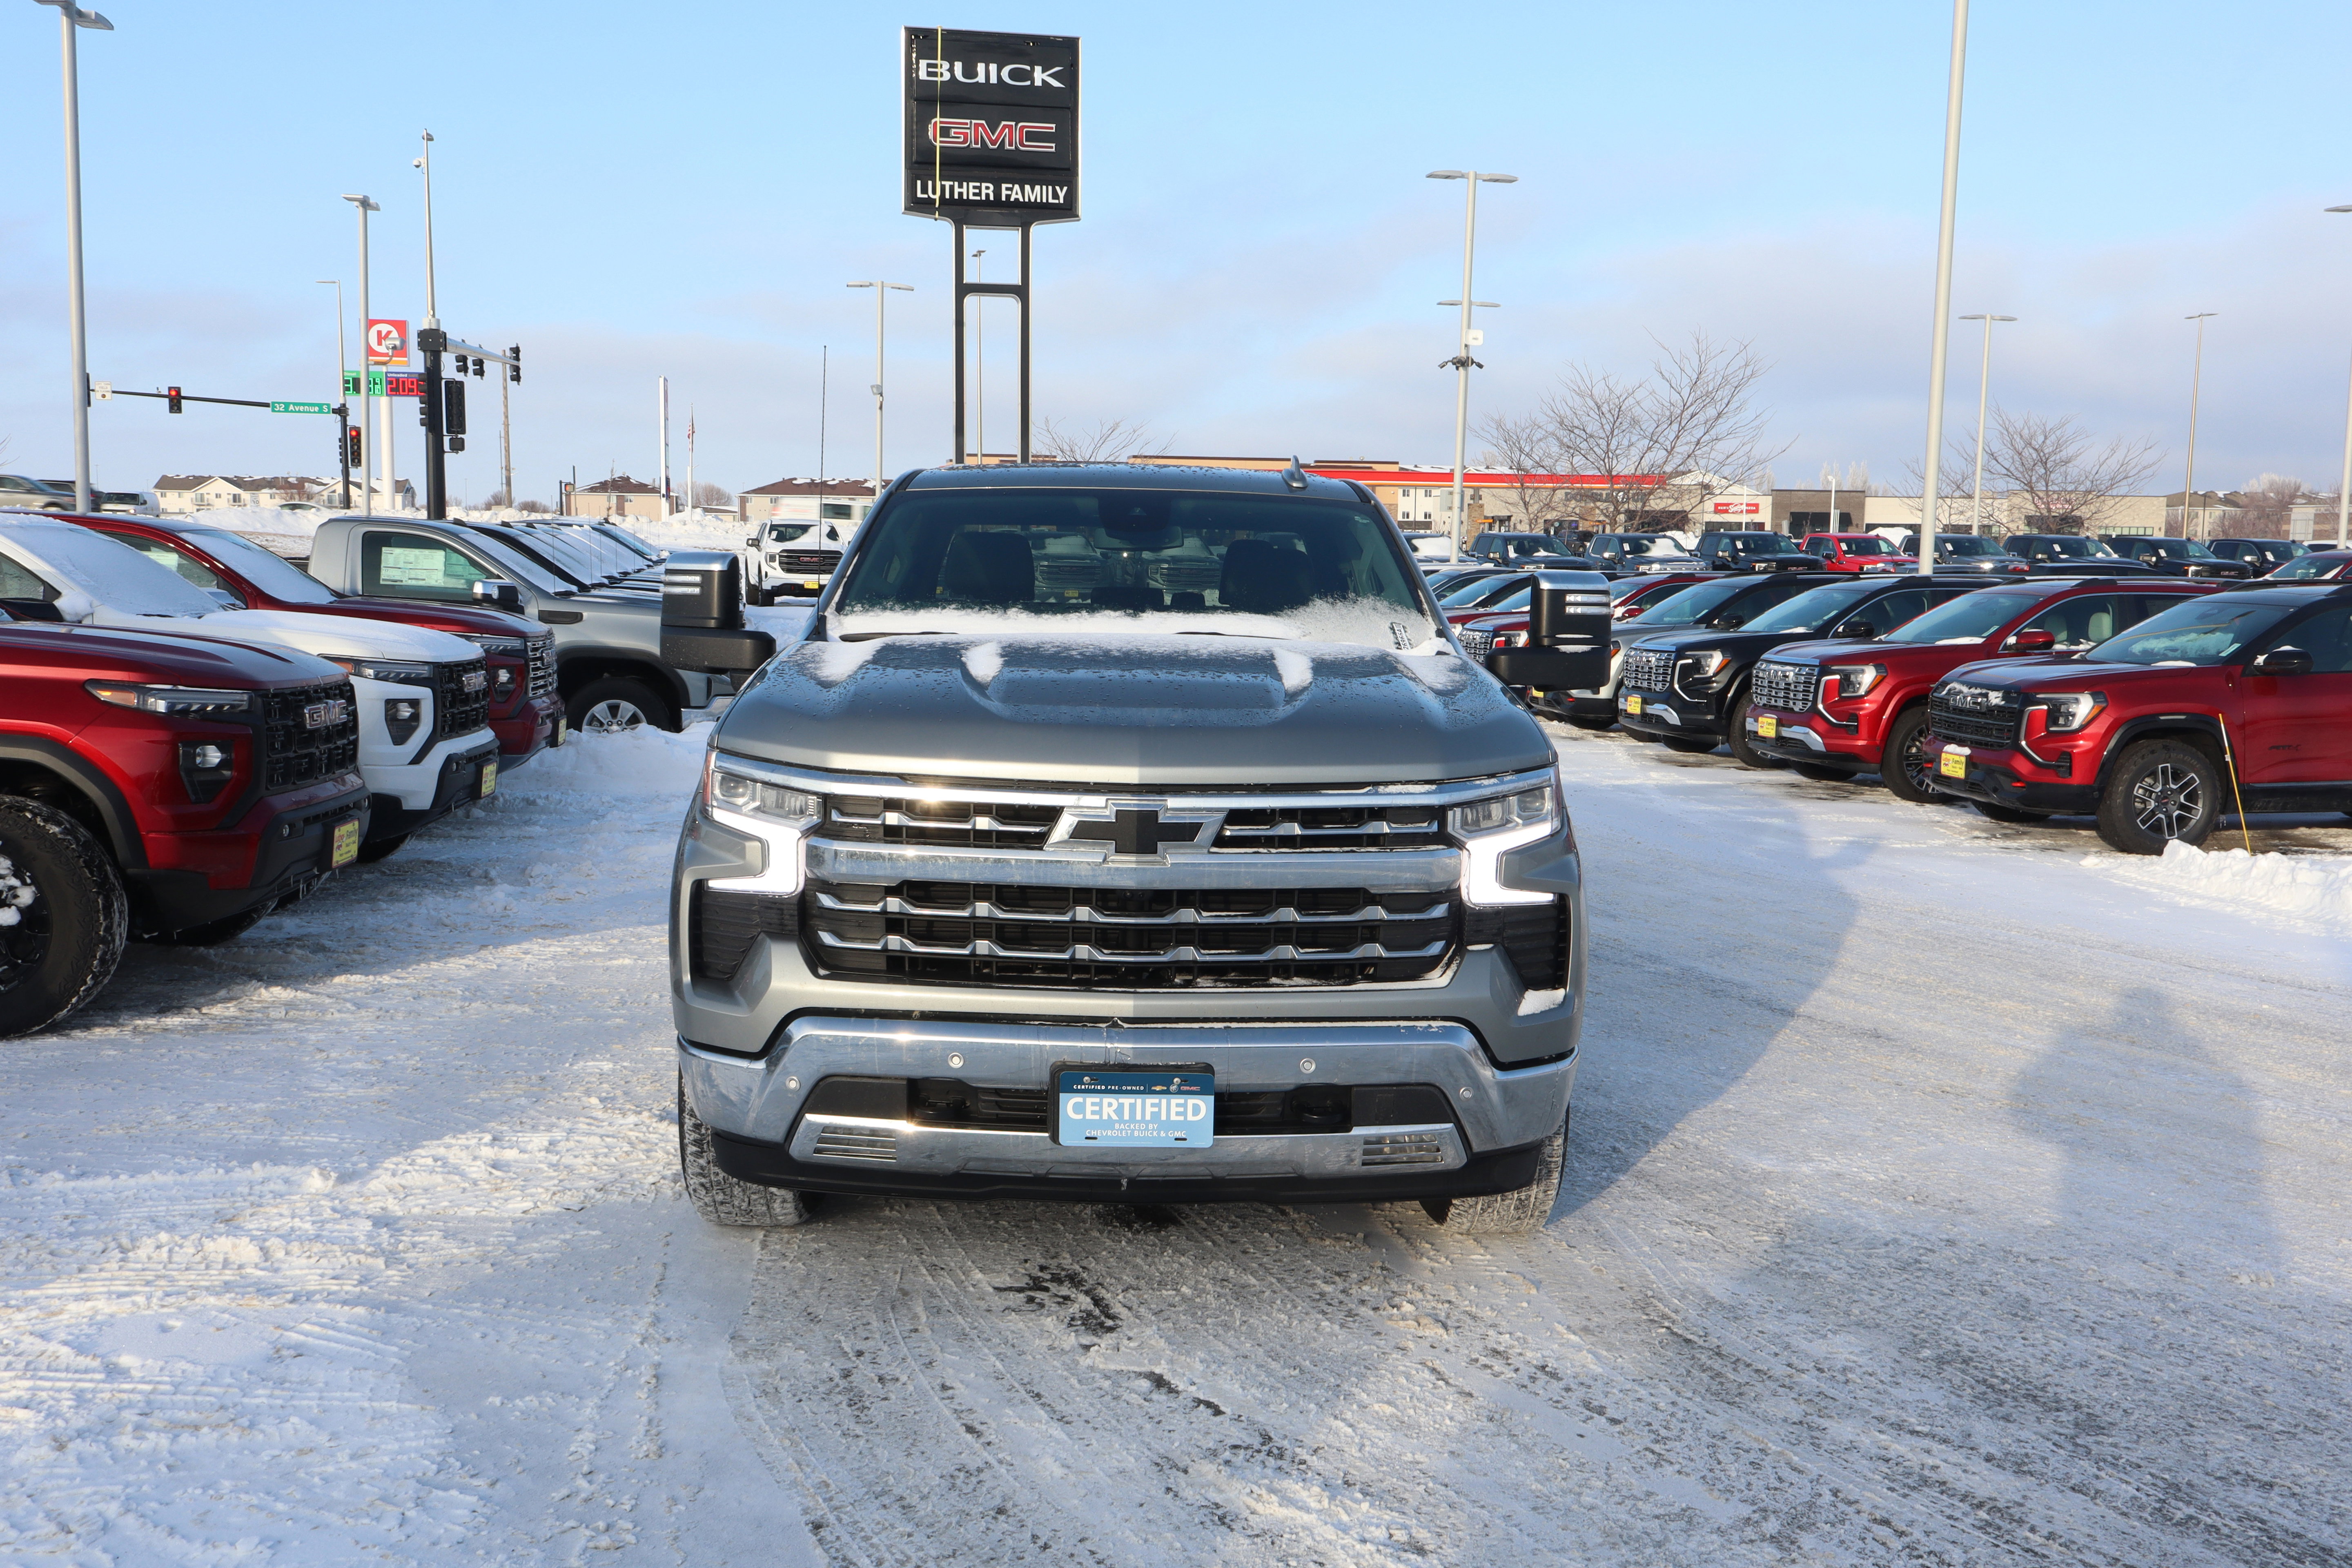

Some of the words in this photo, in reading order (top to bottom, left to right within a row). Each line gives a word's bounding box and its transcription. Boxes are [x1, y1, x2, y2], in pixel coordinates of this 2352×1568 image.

[919, 59, 1066, 88] BUICK
[929, 118, 1056, 152] GMC
[916, 180, 994, 201] LUTHER
[1001, 183, 1068, 204] FAMILY
[377, 330, 393, 346] K
[304, 699, 348, 729] GMC
[1949, 695, 1984, 711] GMC
[1066, 1097, 1207, 1121] CERTIFIED
